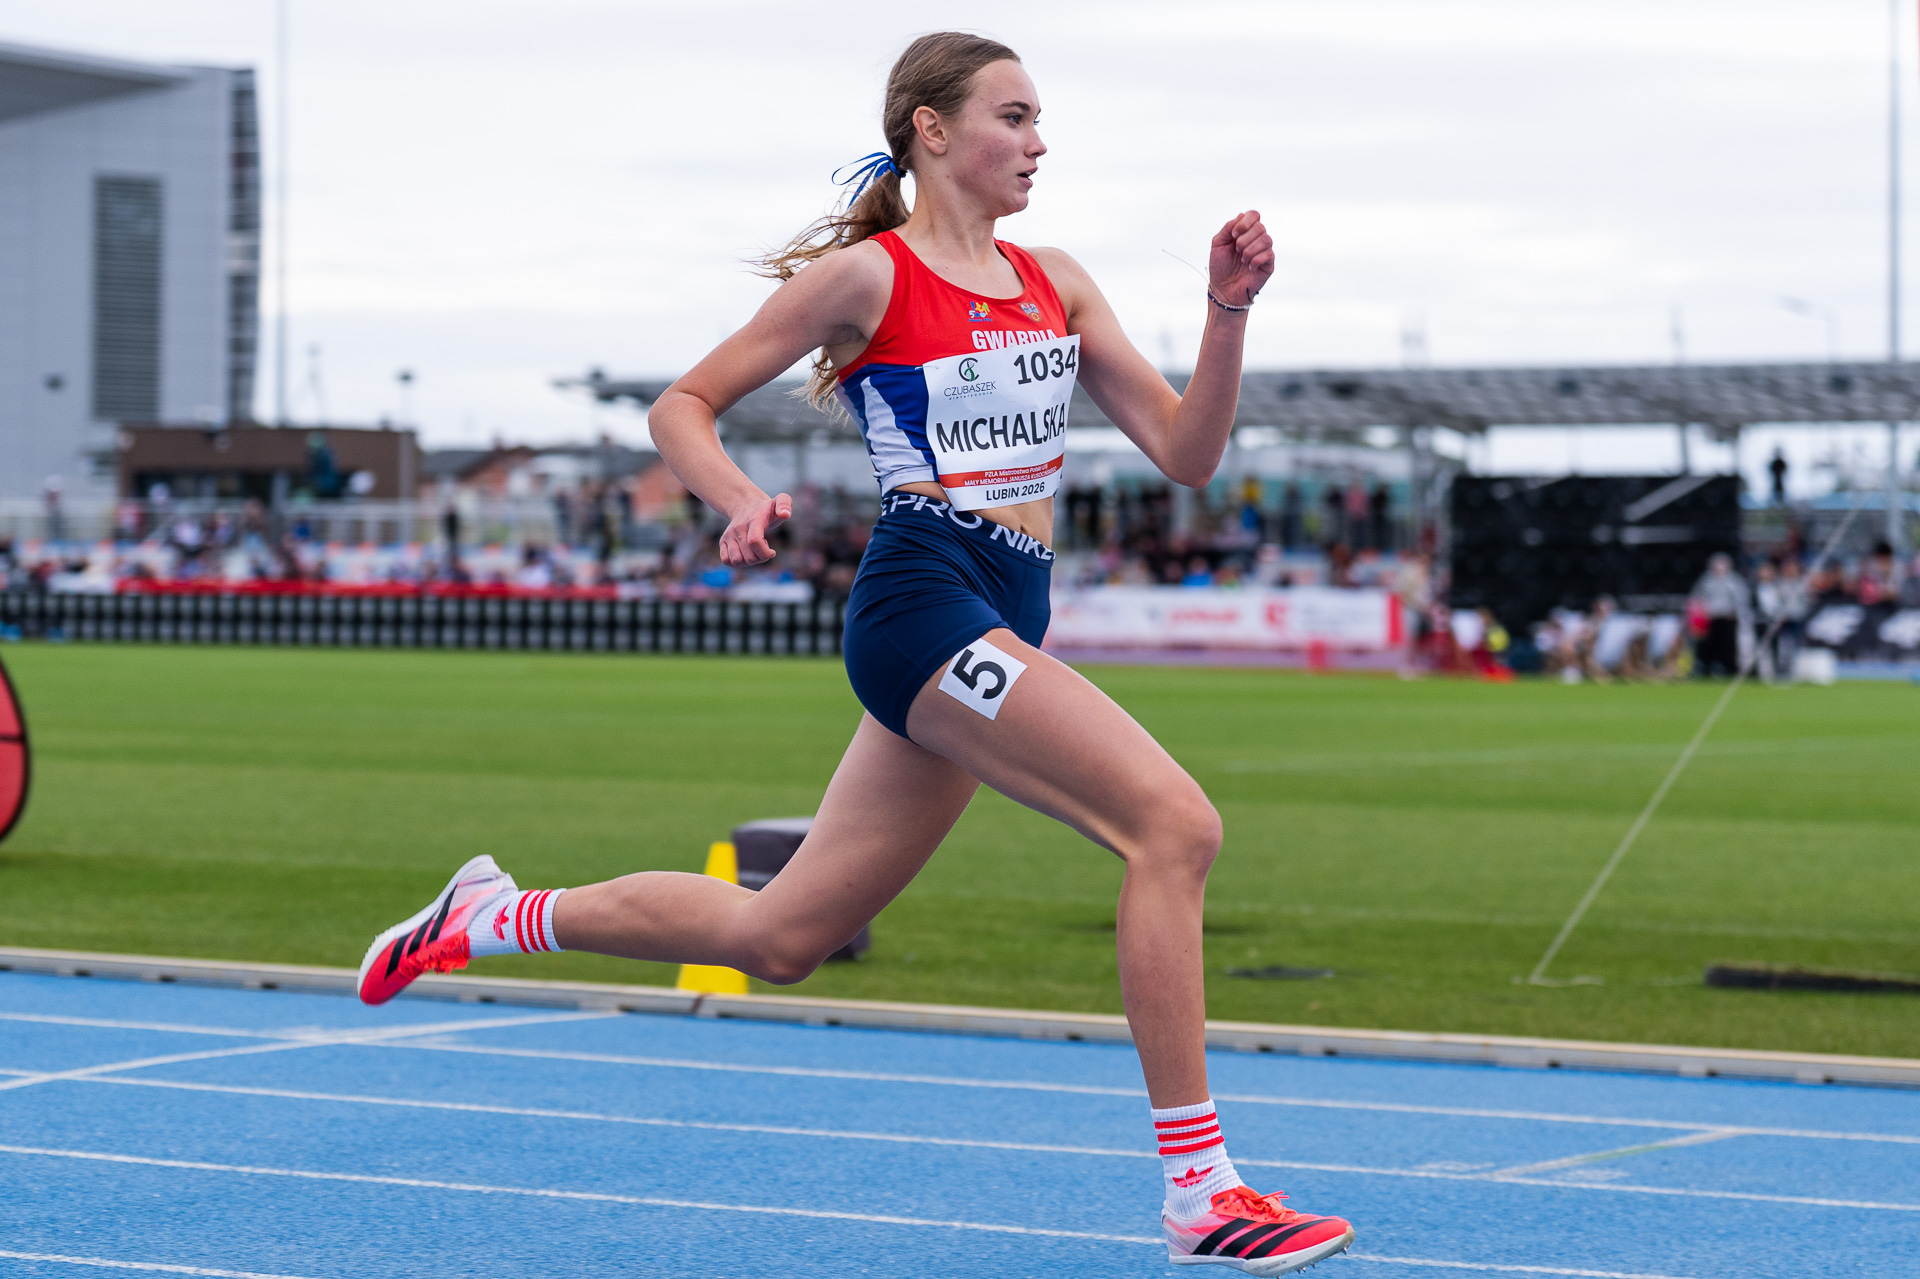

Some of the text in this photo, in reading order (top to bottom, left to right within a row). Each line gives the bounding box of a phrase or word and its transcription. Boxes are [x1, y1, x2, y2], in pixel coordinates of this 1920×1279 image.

[1013, 344, 1076, 385] 1034
[943, 380, 997, 397] CZUBASZEK
[936, 402, 1065, 453] MICHALSKA
[986, 482, 1045, 501] LUBIN 2026
[889, 494, 983, 530] PRO
[951, 648, 1007, 700] 5
